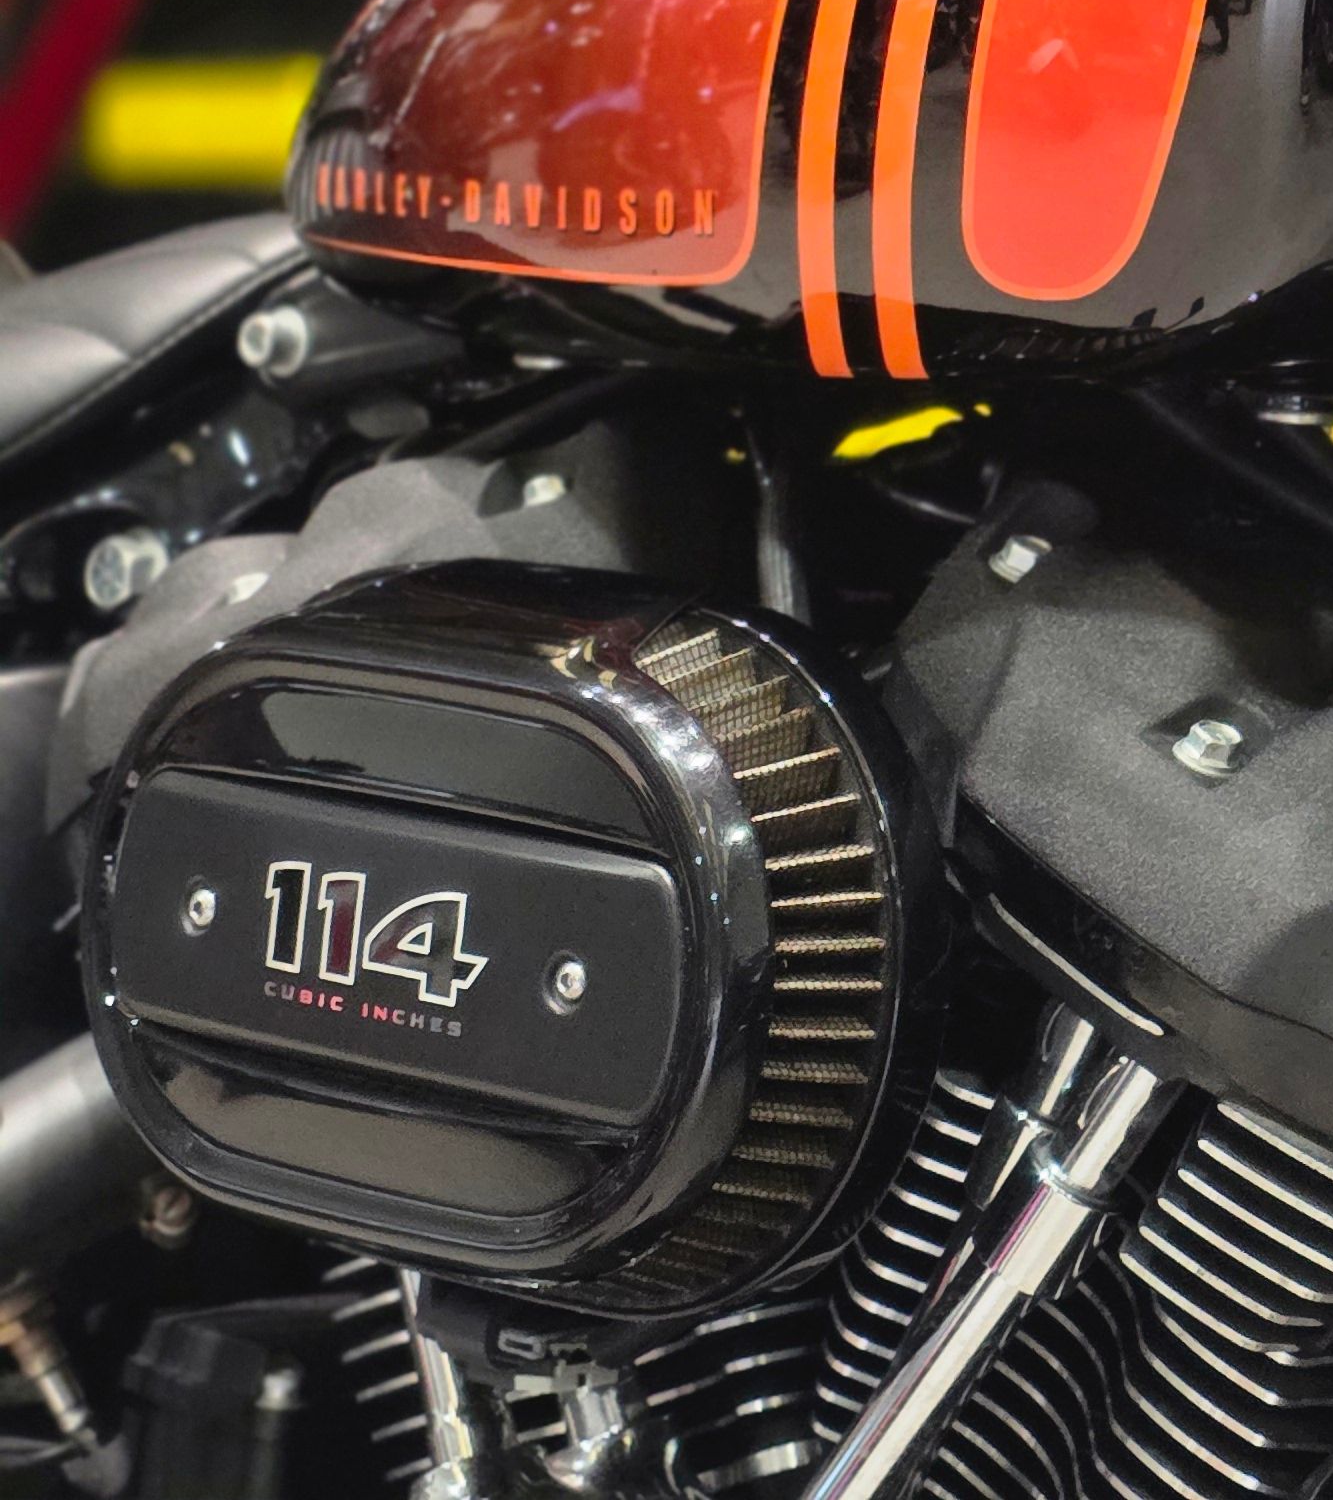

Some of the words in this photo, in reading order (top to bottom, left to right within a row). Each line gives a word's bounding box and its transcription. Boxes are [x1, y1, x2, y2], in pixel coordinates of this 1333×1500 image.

[264, 860, 489, 1008] 114
[263, 980, 345, 1012] CUBIC
[360, 1002, 463, 1037] INCHES
